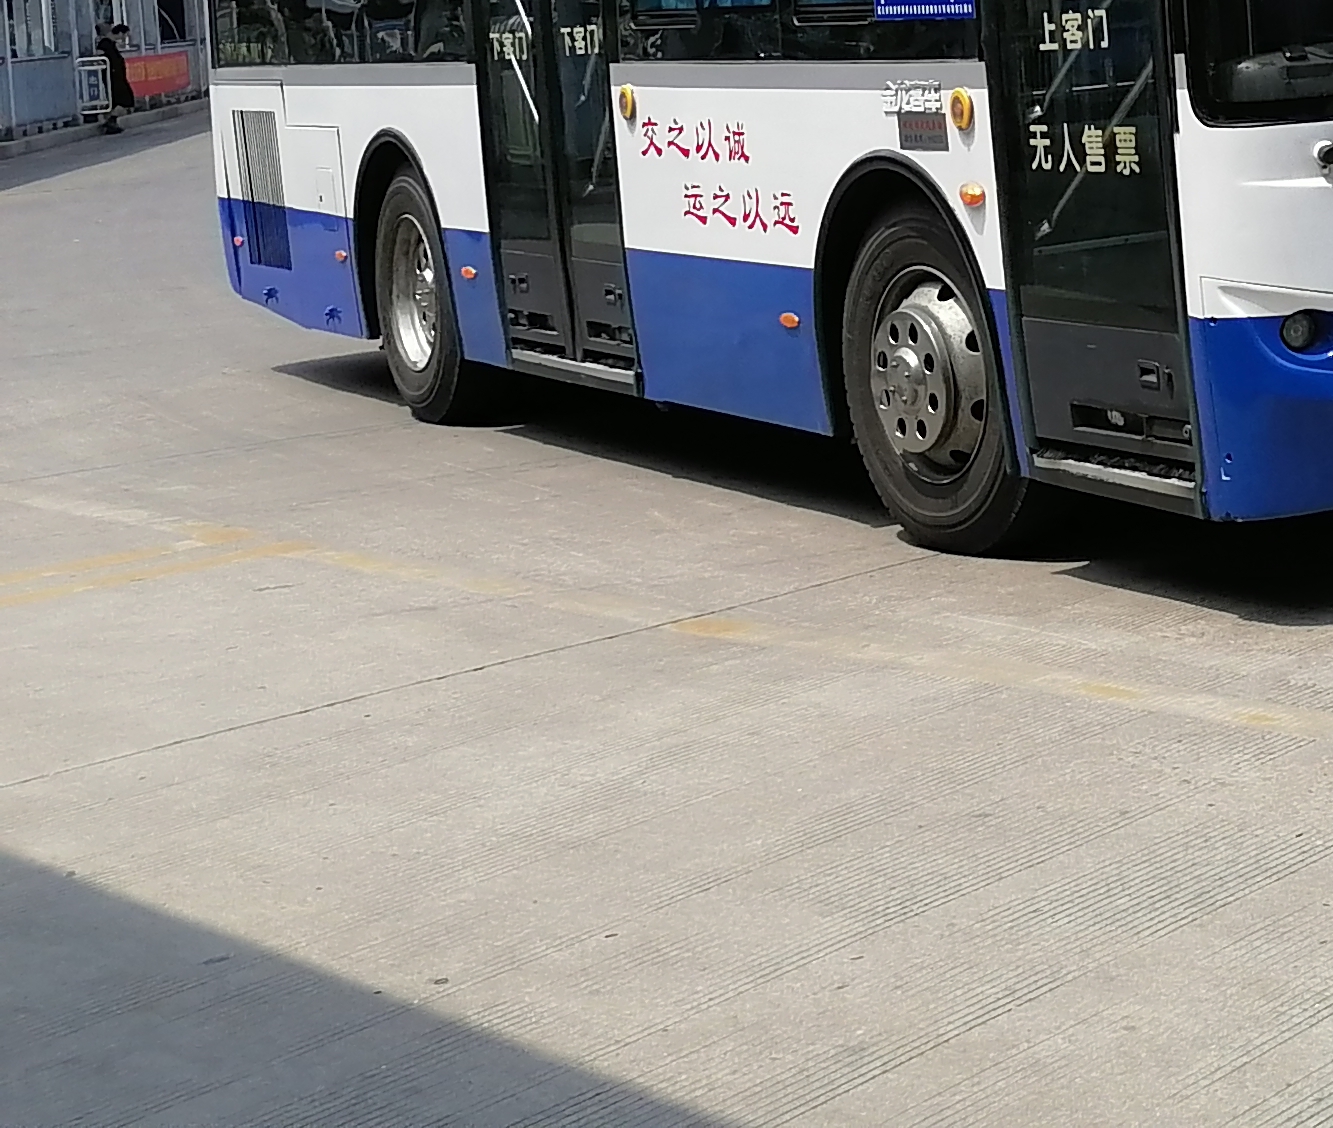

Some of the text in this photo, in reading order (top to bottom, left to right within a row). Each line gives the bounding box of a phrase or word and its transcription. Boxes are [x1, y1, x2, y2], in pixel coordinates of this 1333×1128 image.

[488, 31, 528, 61] 下客门
[560, 24, 599, 57] 下客门
[1039, 8, 1109, 52] 上客门
[641, 115, 751, 164] 交之以诚
[1028, 122, 1141, 177] 无人售票
[683, 182, 800, 236] 运之以远
